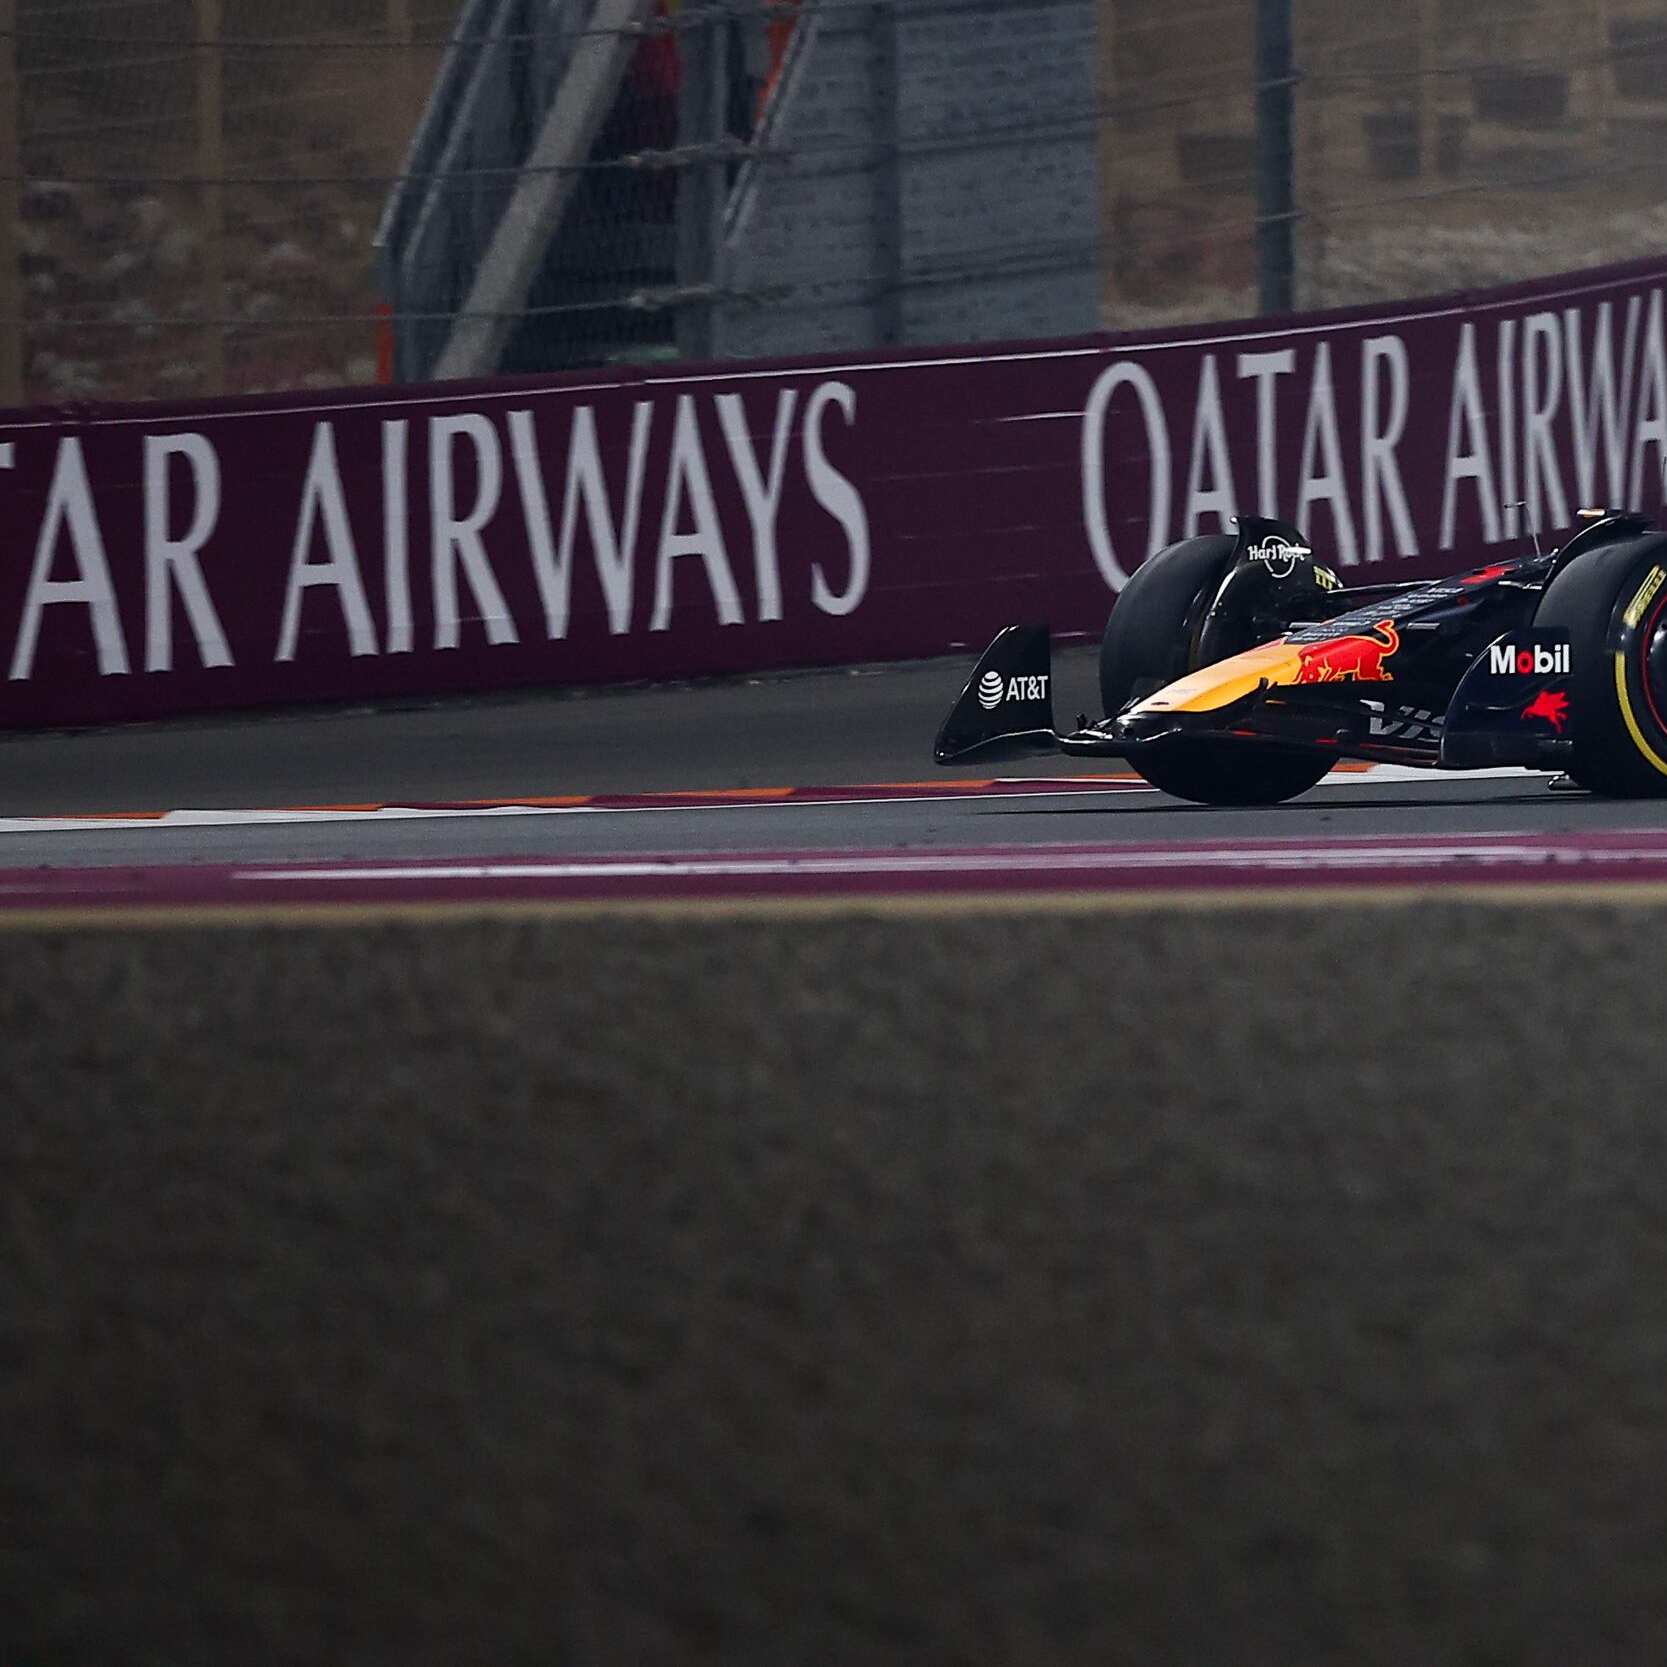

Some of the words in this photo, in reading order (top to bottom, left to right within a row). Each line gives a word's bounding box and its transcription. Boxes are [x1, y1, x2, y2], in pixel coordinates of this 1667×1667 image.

[0, 432, 235, 680] AR
[275, 381, 871, 663] AIRWAYS
[1081, 336, 1418, 593] QATAR
[1005, 675, 1049, 702] AT&T
[1490, 645, 1570, 676] Mobil
